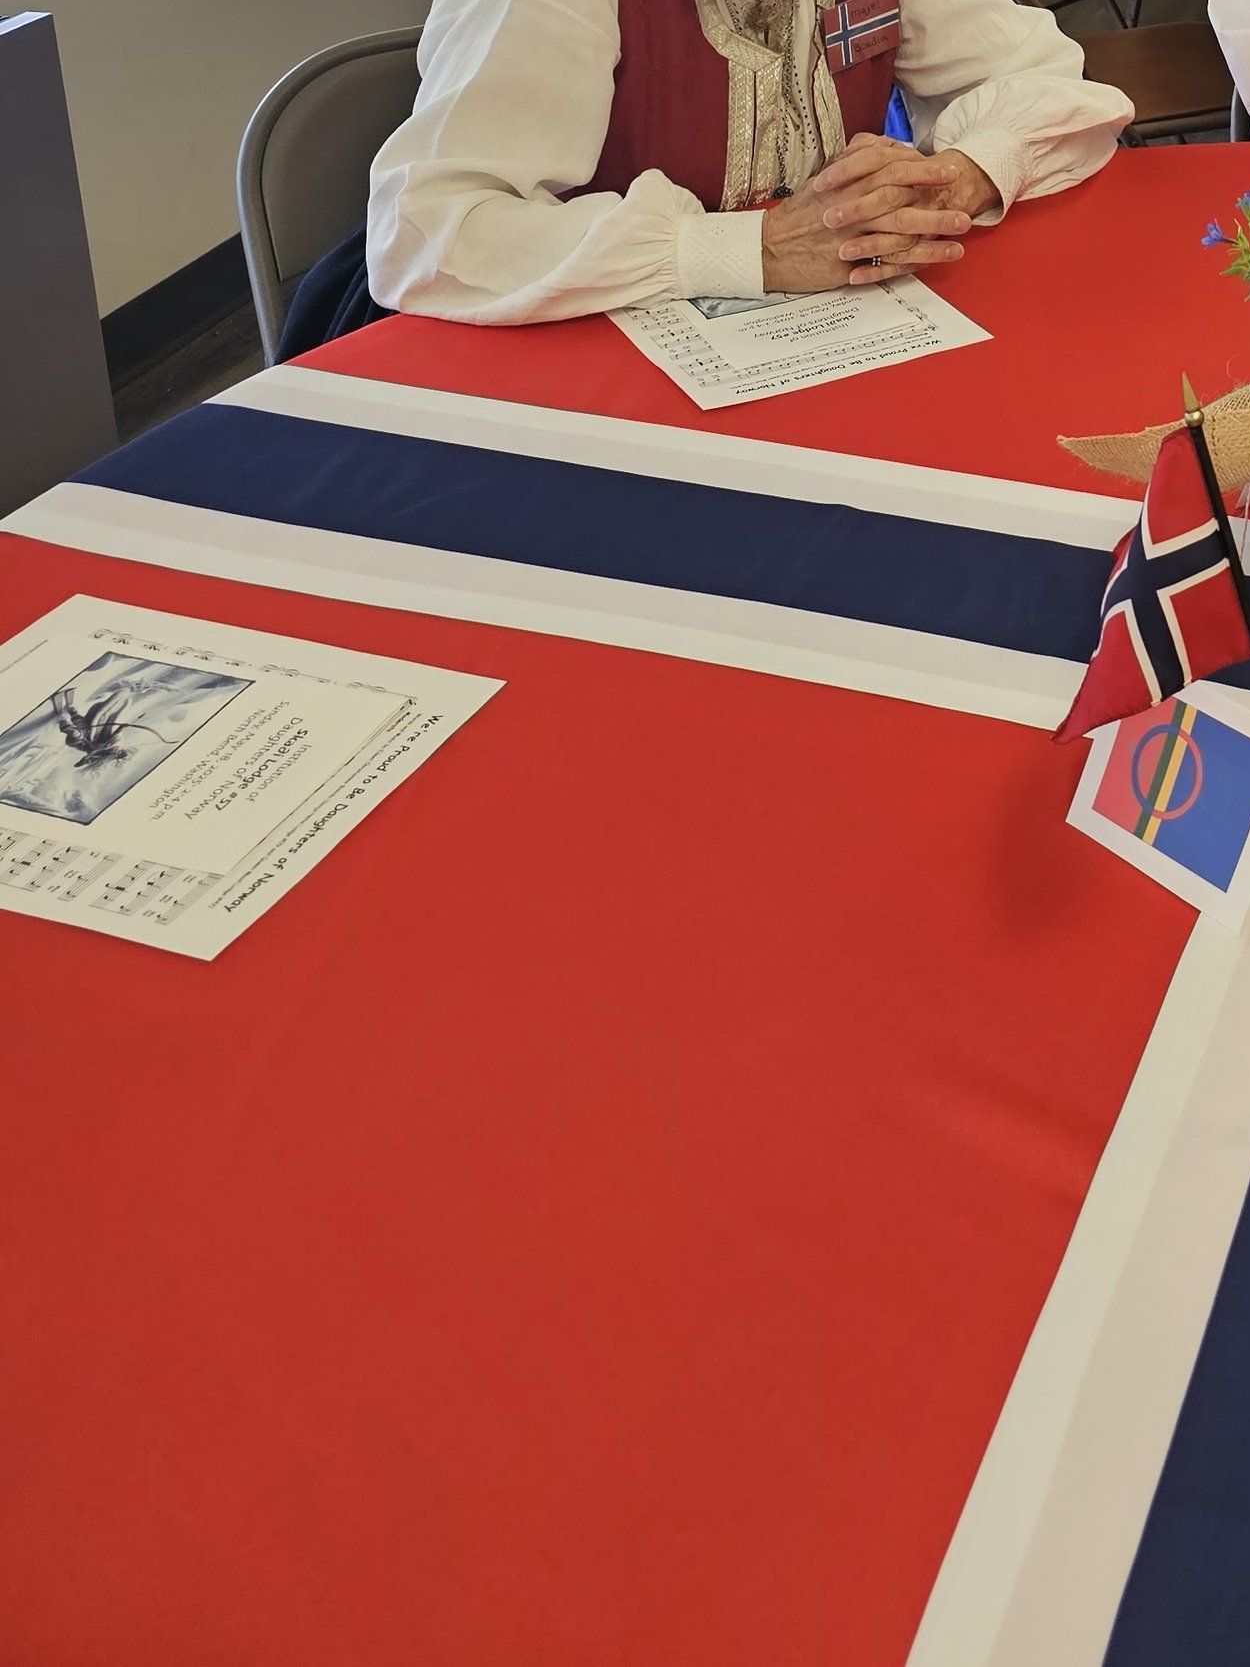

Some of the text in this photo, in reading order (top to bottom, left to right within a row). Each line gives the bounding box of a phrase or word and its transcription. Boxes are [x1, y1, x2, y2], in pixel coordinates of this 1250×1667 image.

[228, 730, 256, 750] May
[404, 714, 445, 743] We're
[147, 708, 266, 809] North Bend, Washington
[182, 716, 304, 820] Daughters of Norway
[255, 743, 313, 791] Institution
[374, 744, 412, 772] Proud
[235, 758, 278, 790] Lodge
[360, 774, 380, 785] to
[213, 790, 240, 811] #57
[243, 791, 261, 803] of
[343, 786, 366, 800] Be
[285, 802, 349, 855] Daughters
[270, 856, 290, 870] of
[221, 871, 276, 914] Norway
